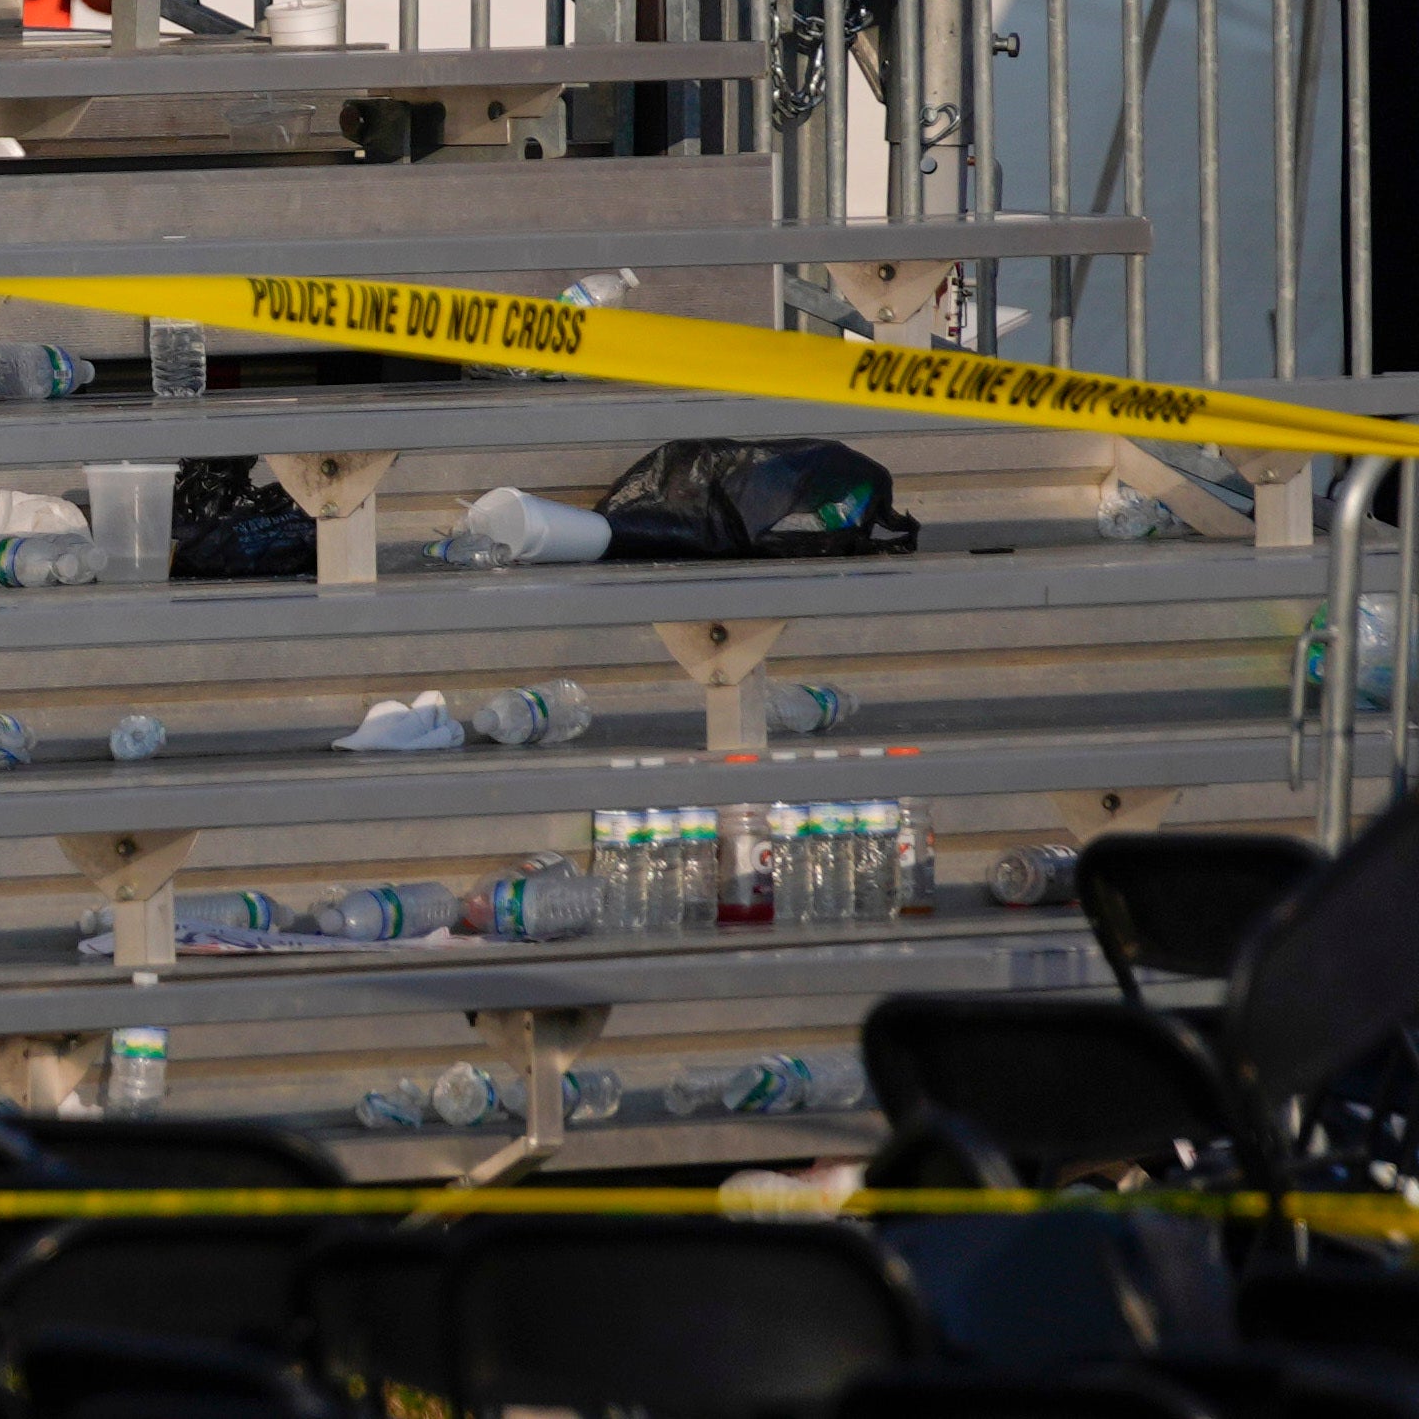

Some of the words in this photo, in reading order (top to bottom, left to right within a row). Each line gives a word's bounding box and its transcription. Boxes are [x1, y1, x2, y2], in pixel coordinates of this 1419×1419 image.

[248, 277, 338, 328] POLICE
[346, 284, 400, 335] LINE
[407, 289, 442, 340] DO
[447, 293, 500, 345] NOT
[502, 299, 587, 355] CROSS
[849, 348, 950, 398] POLICE
[946, 360, 1013, 404] LINE
[1008, 369, 1056, 409] DO
[1050, 375, 1117, 414] NOT
